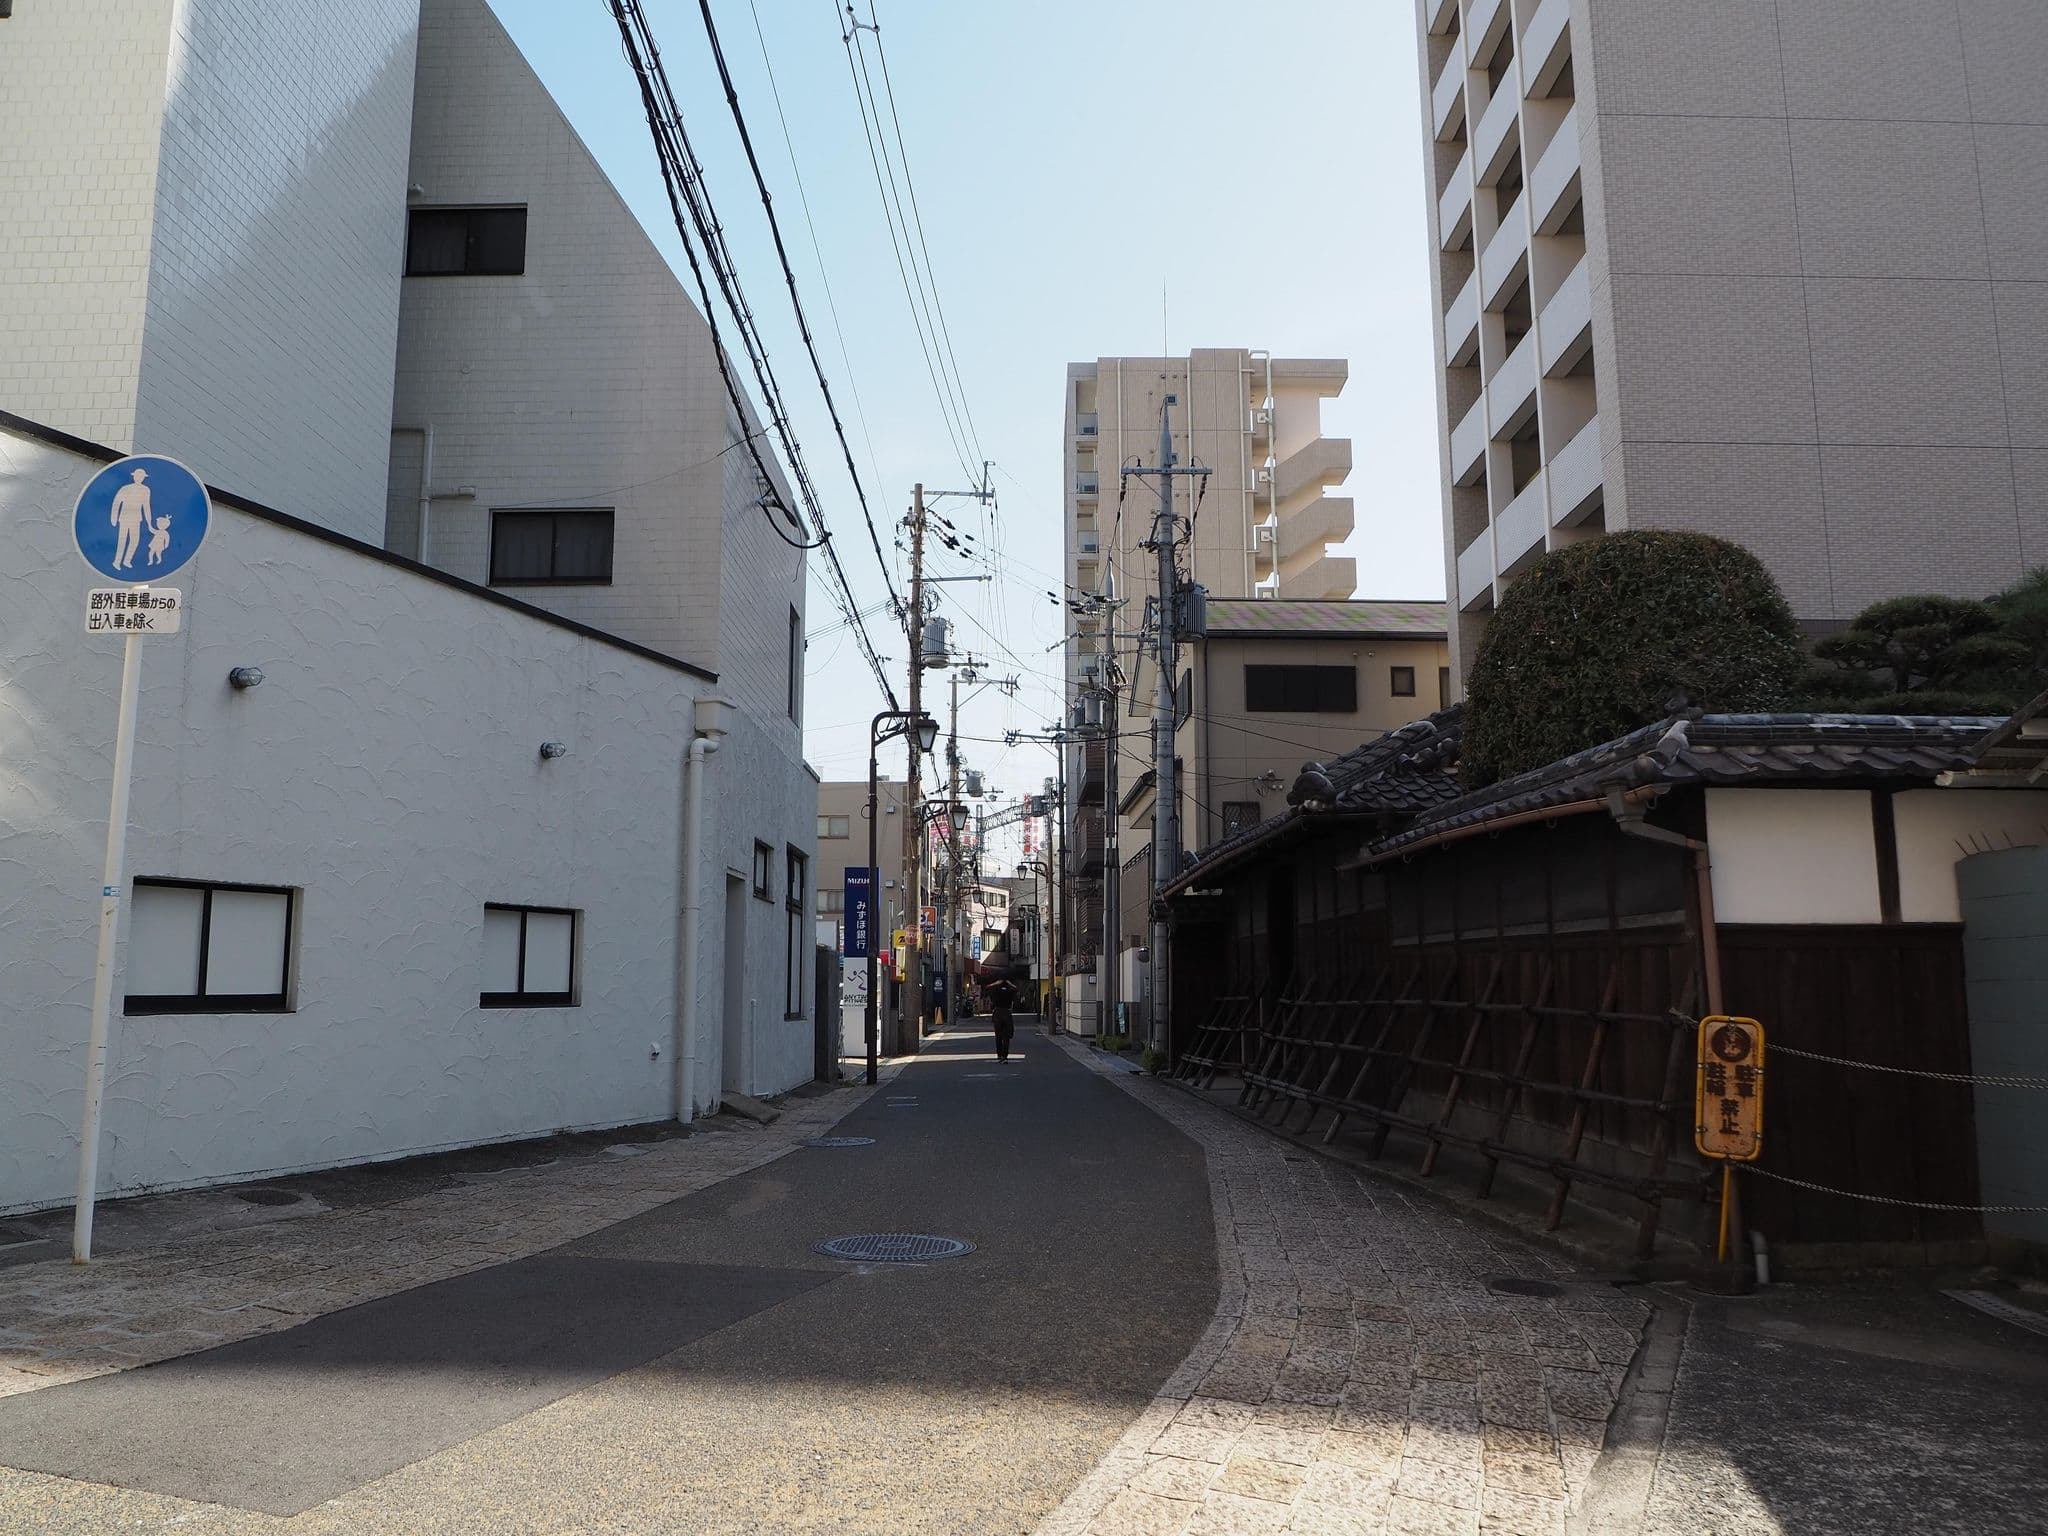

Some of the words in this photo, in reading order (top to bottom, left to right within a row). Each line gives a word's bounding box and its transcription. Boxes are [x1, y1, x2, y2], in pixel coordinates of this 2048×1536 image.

[91, 592, 176, 610] 路外駐車場からの
[89, 612, 154, 630] 出入車を除く
[856, 900, 866, 949] みずほ銀行
[1719, 1098, 1740, 1135] 禁止
